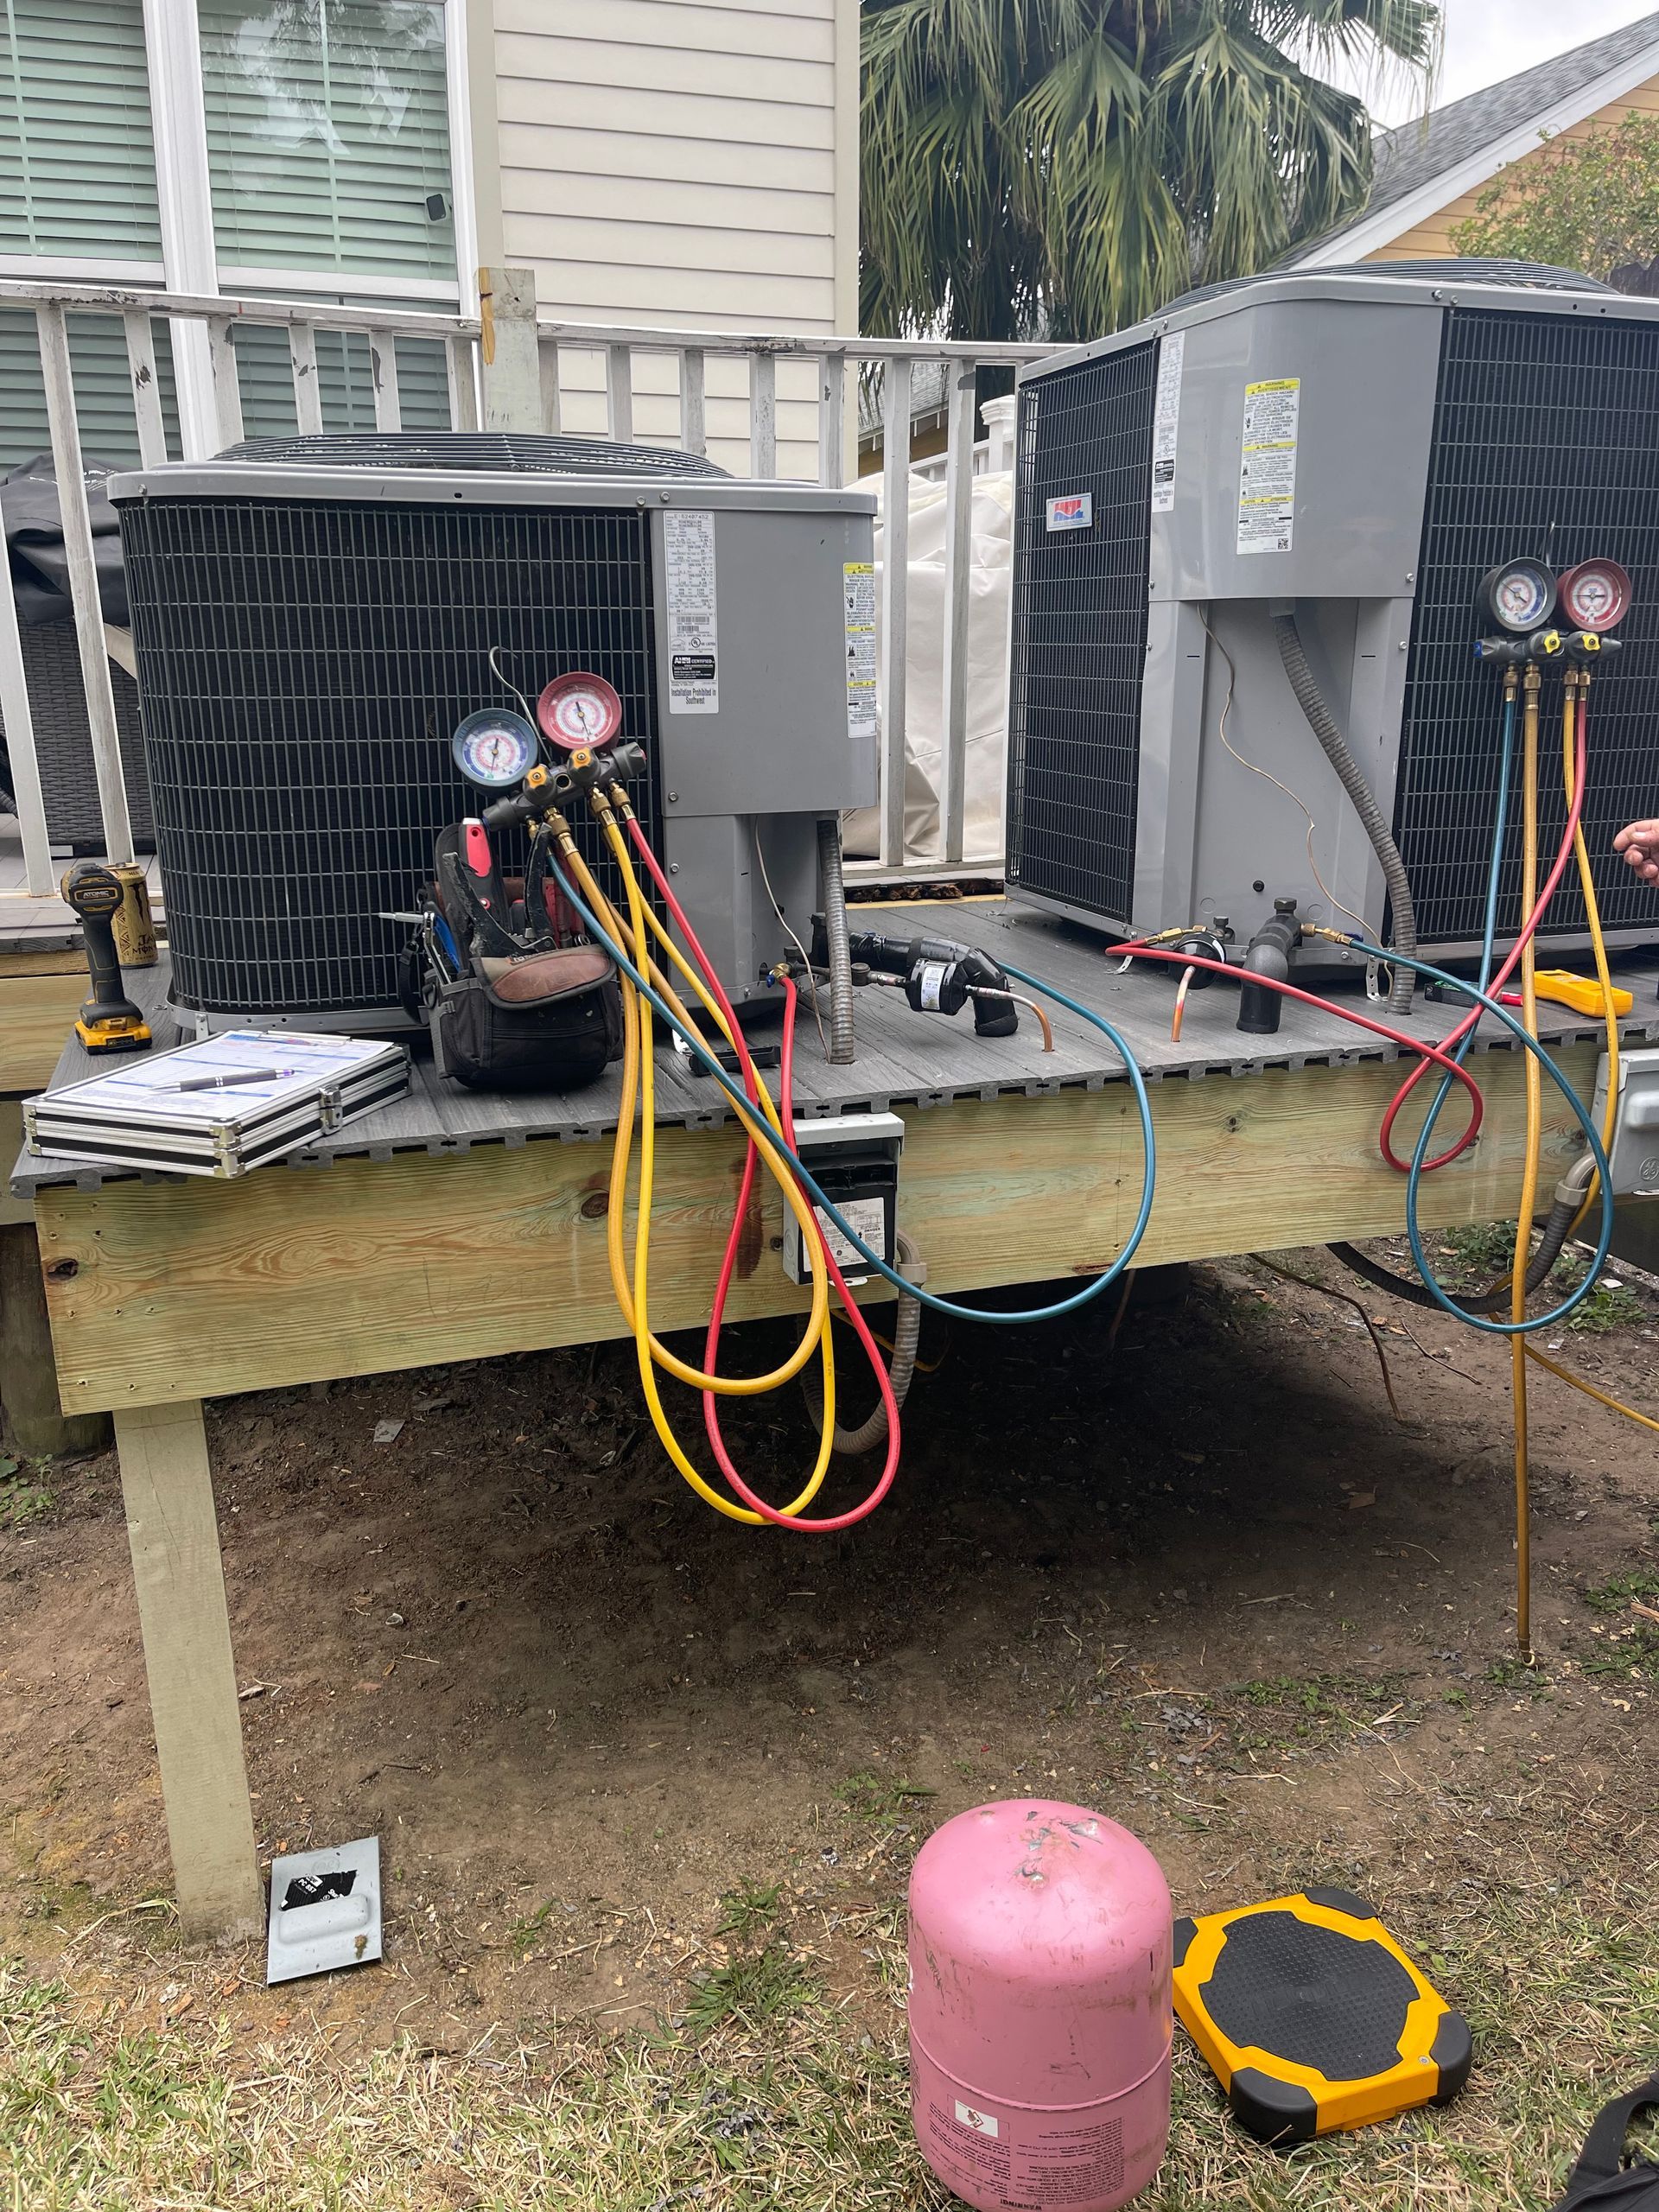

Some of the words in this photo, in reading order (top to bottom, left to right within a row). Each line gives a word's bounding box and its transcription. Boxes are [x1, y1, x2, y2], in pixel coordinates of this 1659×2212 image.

[671, 688, 691, 696] Installation
[693, 688, 711, 696] Prohibited
[1000, 2198, 1042, 2210] WARNING!
